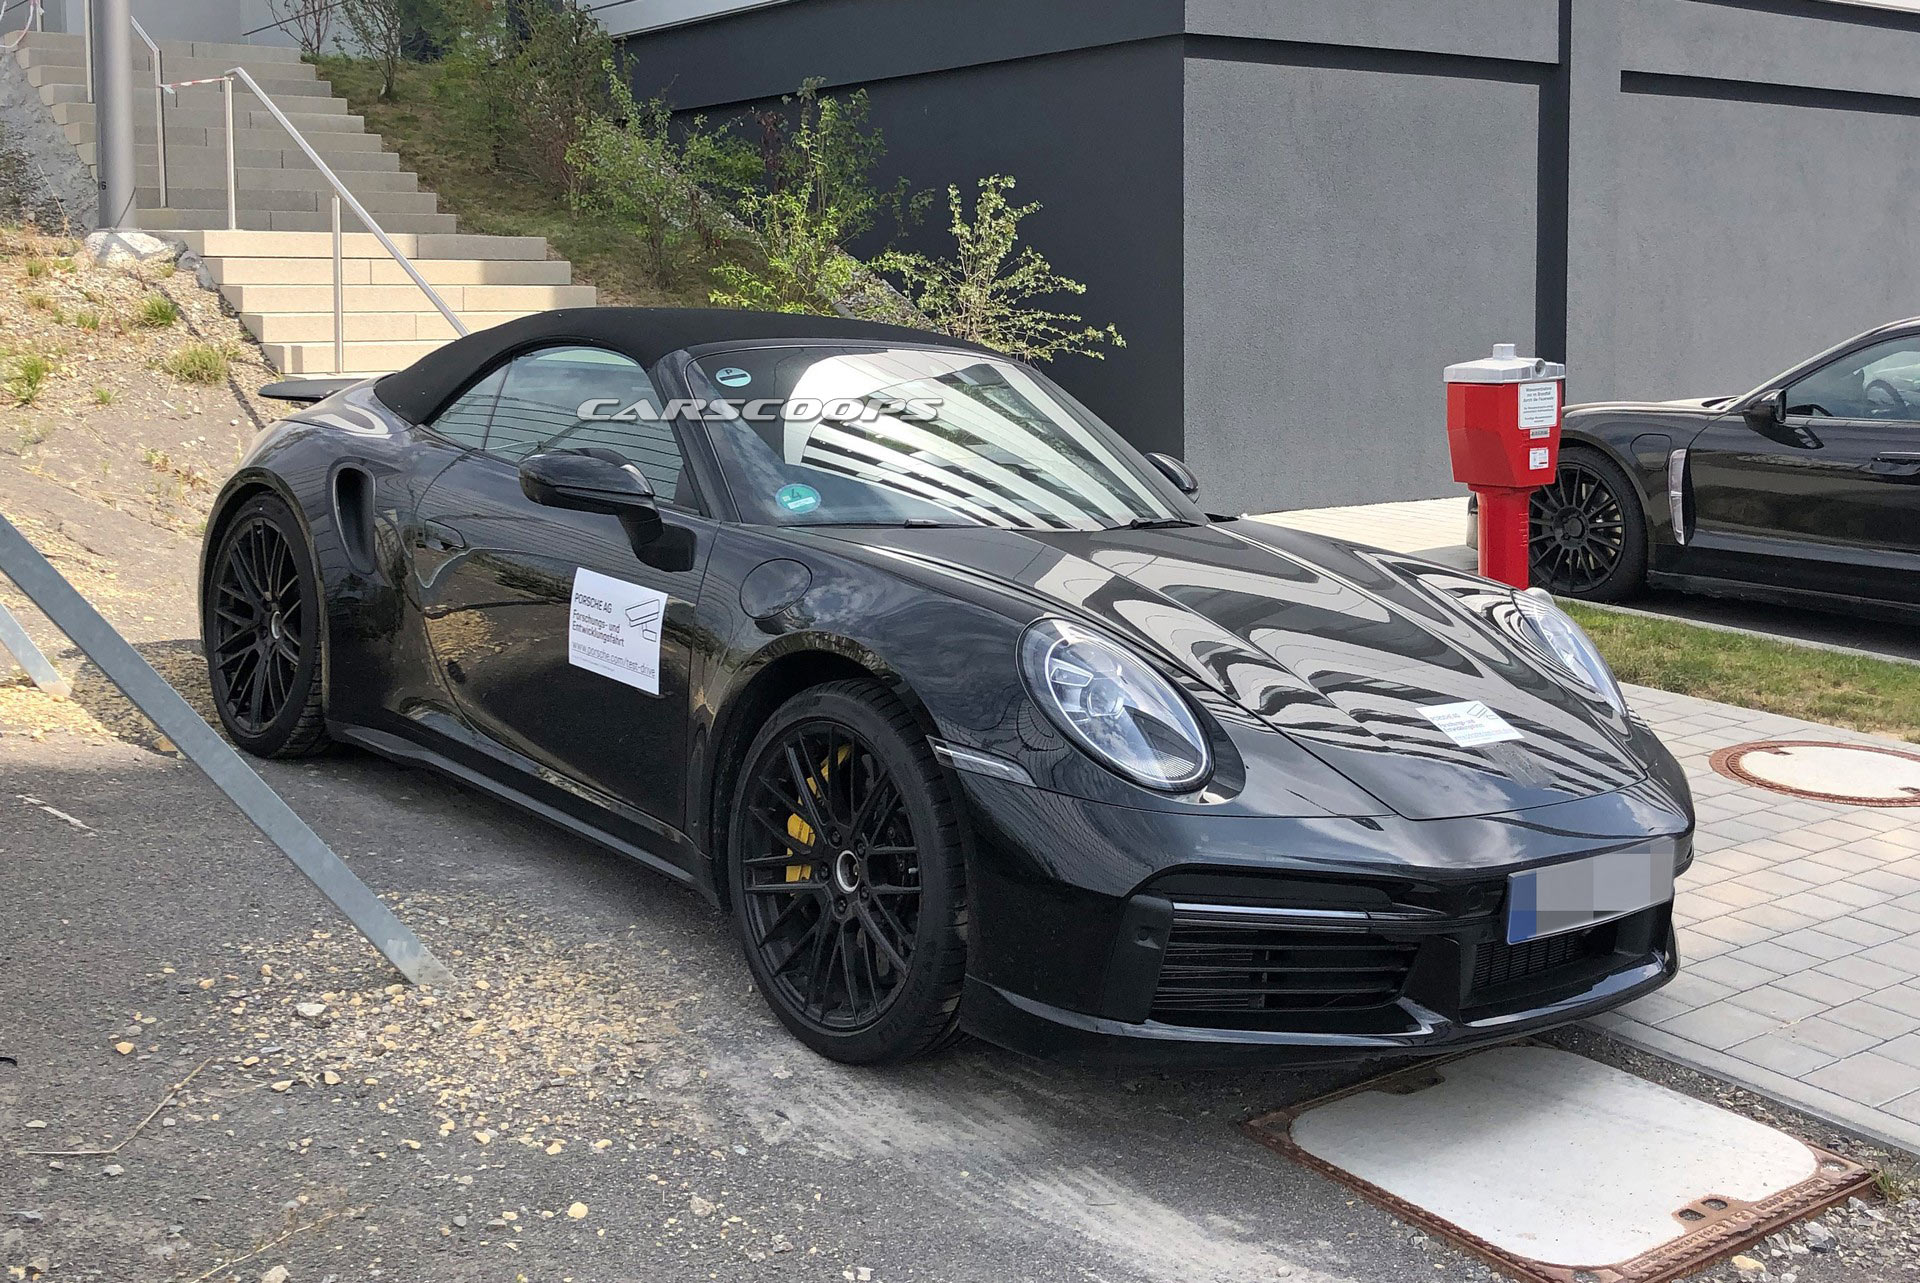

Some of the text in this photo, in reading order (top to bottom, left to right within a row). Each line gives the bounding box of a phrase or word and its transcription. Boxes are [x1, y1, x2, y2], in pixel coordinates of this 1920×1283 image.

[575, 592, 613, 614] PORSCHE AG
[572, 620, 625, 647] Entwicklungsfahrt
[573, 609, 620, 634] Forschungs- und
